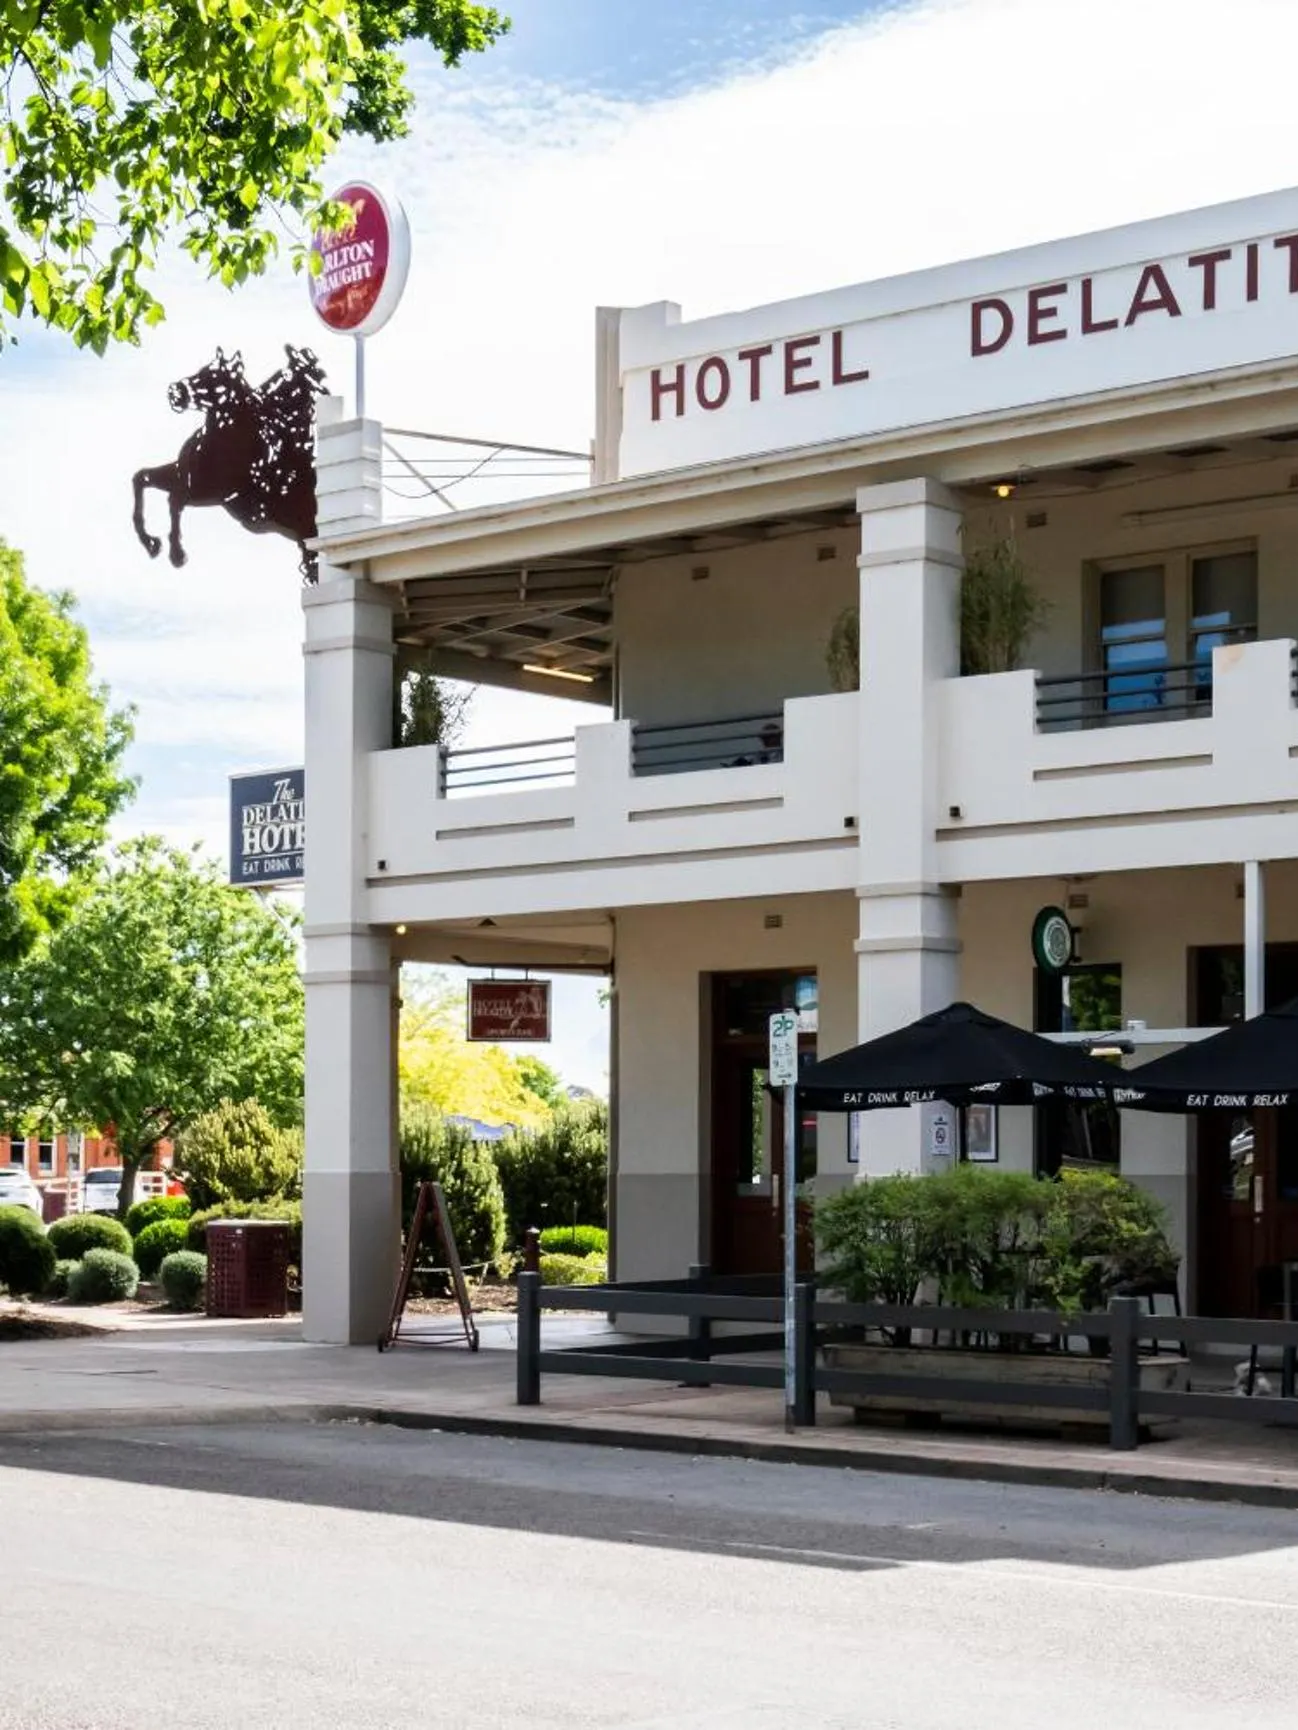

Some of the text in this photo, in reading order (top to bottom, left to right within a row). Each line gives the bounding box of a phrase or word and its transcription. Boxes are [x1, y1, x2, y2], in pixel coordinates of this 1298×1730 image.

[319, 240, 375, 273] RLTON
[651, 331, 870, 422] HOTEL
[272, 778, 295, 805] The
[242, 861, 260, 875] EAT
[264, 857, 291, 872] DRINK
[772, 1019, 794, 1037] 2P
[844, 1090, 936, 1104] EAT DRINK RELAX
[1186, 1093, 1289, 1106] EAT DRINK RELAX
